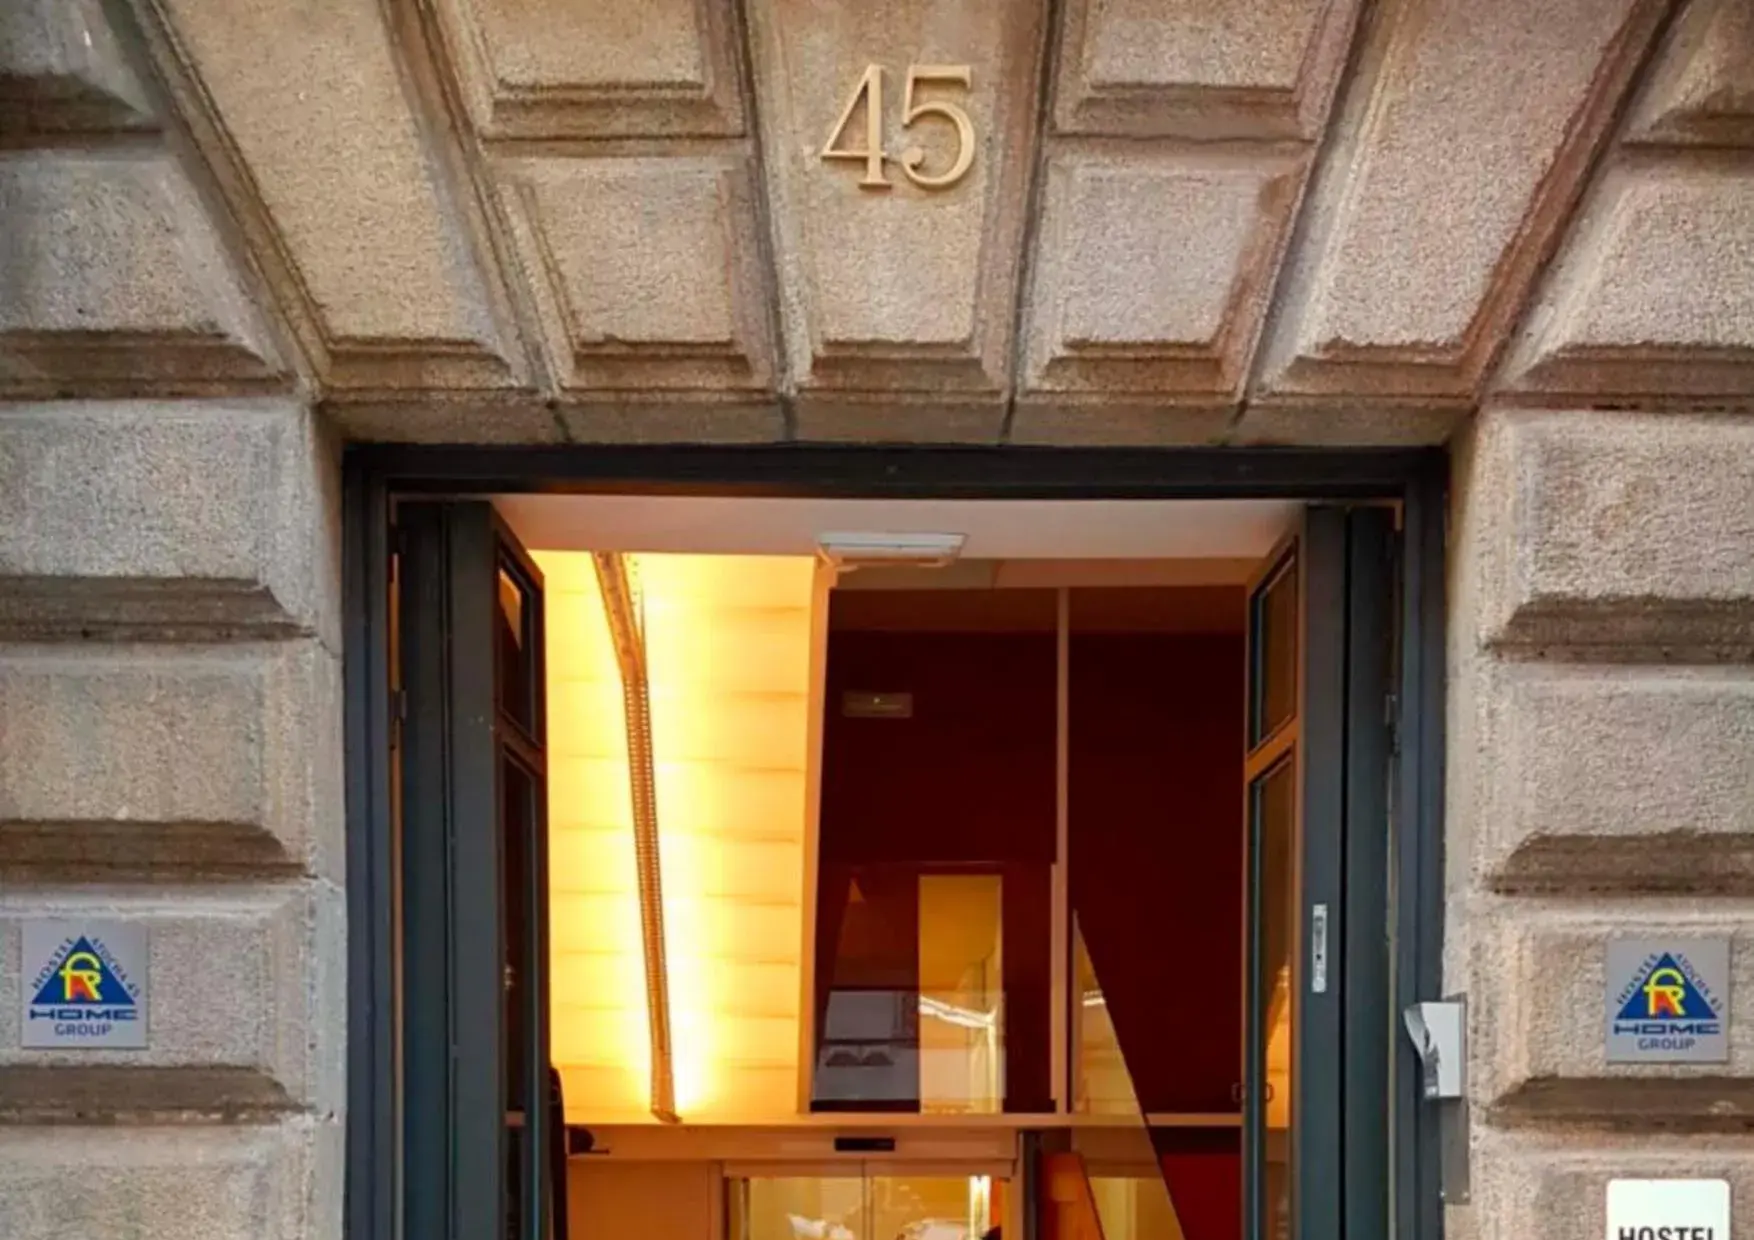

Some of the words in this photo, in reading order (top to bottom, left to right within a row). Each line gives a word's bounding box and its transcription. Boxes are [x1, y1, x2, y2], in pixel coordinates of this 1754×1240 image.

[819, 63, 975, 189] 45
[29, 1008, 139, 1021] HOME
[54, 1023, 113, 1036] GROUP
[1613, 1024, 1721, 1035] HOME
[1637, 1038, 1696, 1051] GROUP
